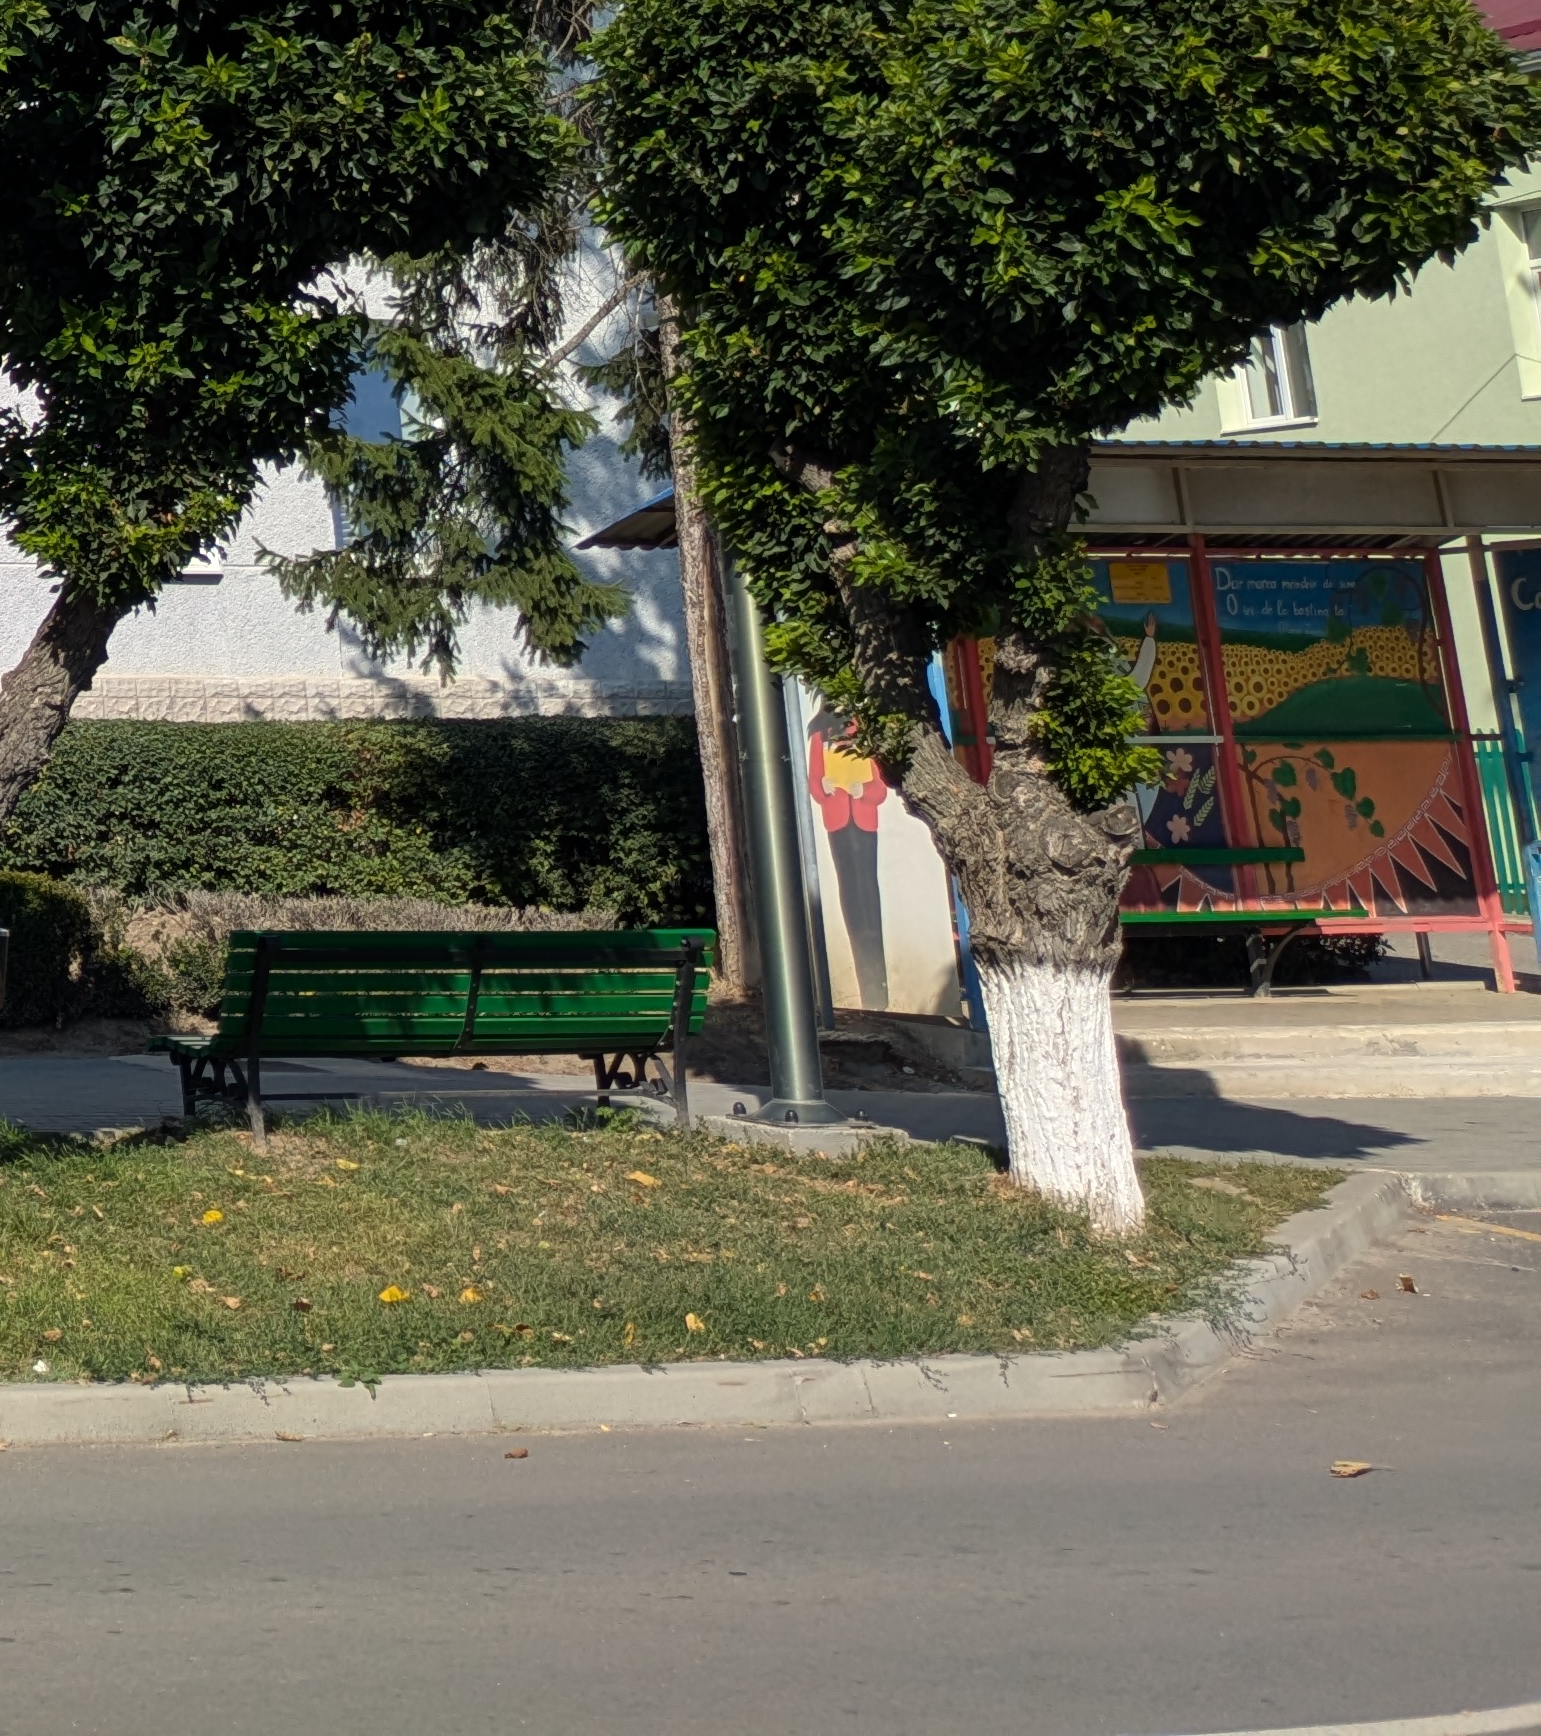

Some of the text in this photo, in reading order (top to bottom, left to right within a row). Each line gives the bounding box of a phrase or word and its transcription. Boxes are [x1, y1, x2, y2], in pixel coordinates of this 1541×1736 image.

[1225, 593, 1238, 616] O
[1260, 599, 1273, 616] de
[1276, 599, 1288, 616] la
